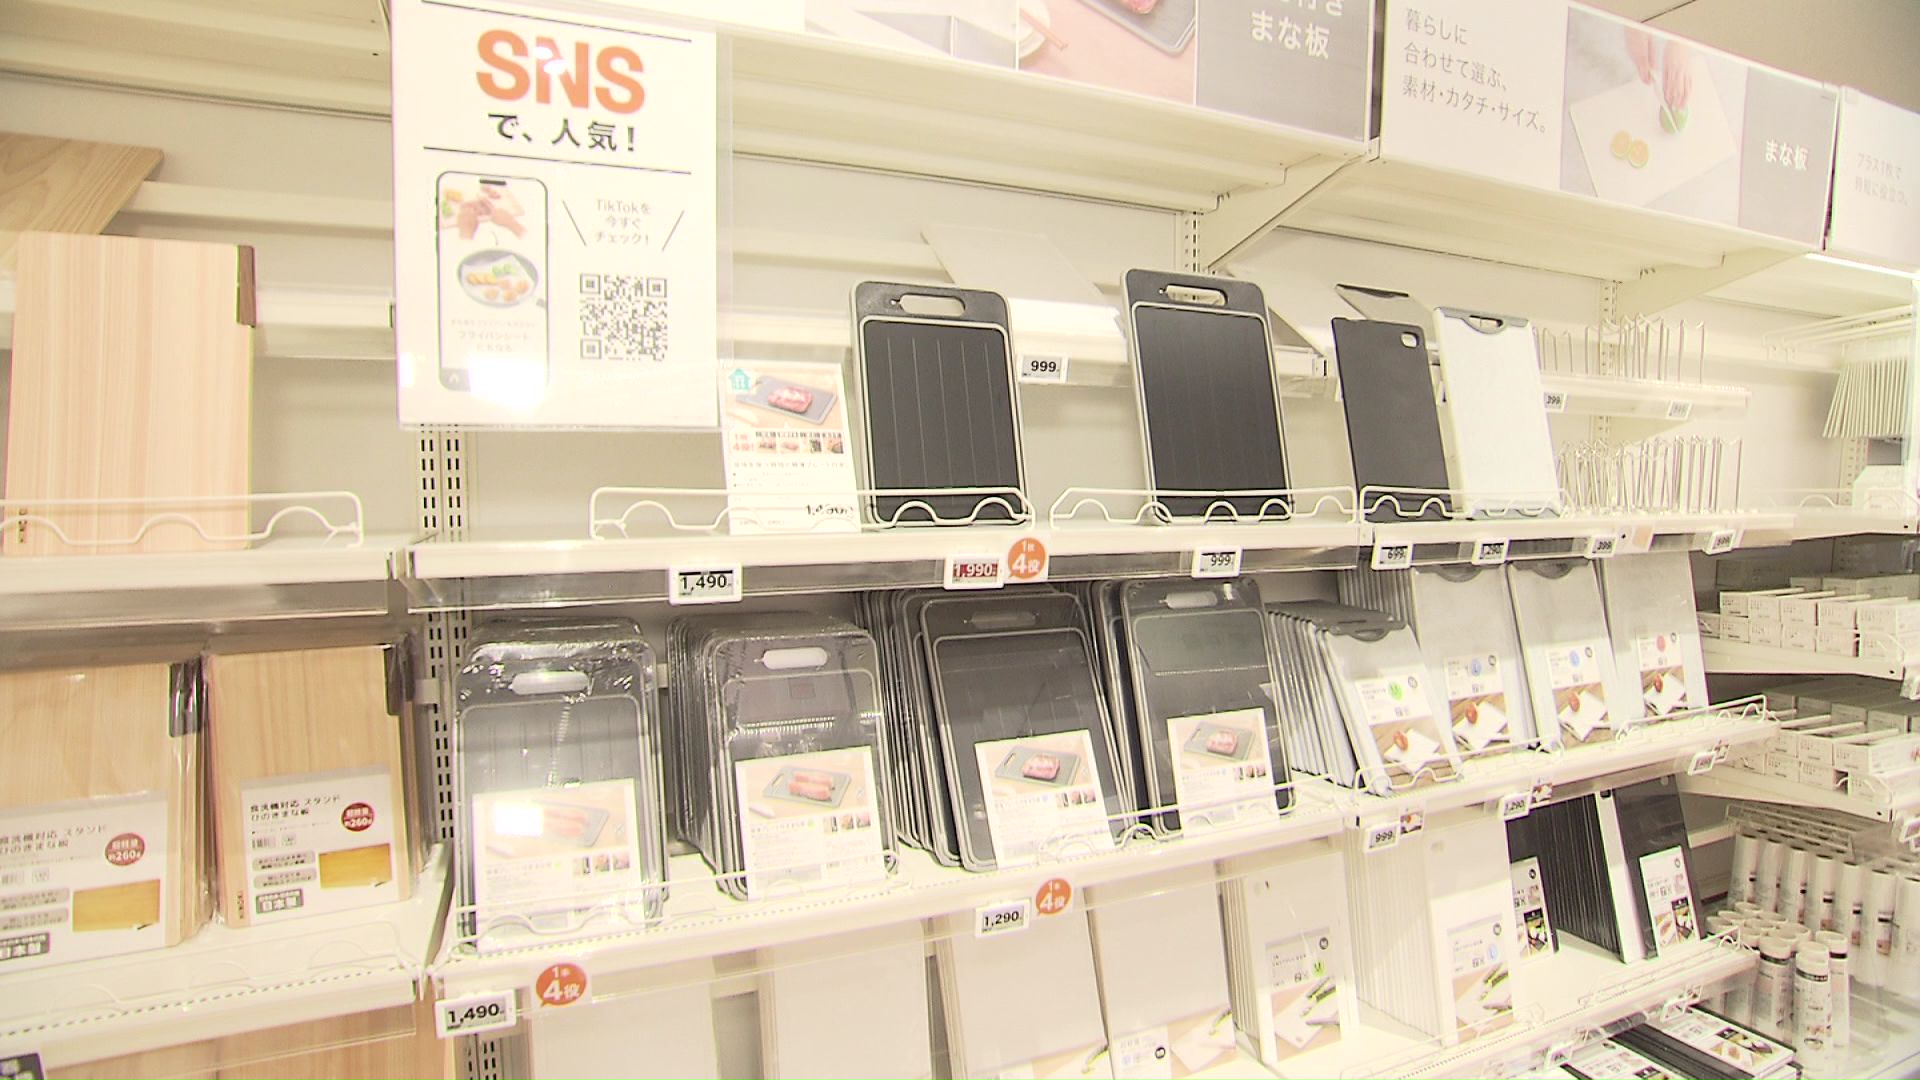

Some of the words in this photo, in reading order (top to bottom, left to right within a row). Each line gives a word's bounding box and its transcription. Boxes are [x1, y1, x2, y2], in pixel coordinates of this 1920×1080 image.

[1251, 10, 1331, 60] まな板
[1405, 9, 1469, 46] 暮らしに
[476, 29, 646, 115] SNS
[1403, 42, 1508, 92] 合わせて選ぶ、
[1764, 140, 1809, 171] まな板
[1031, 360, 1057, 373] 999
[679, 574, 728, 593] 1,490
[953, 563, 992, 578] 1,990
[984, 911, 1019, 928] 1,290
[448, 1002, 500, 1024] 1,490
